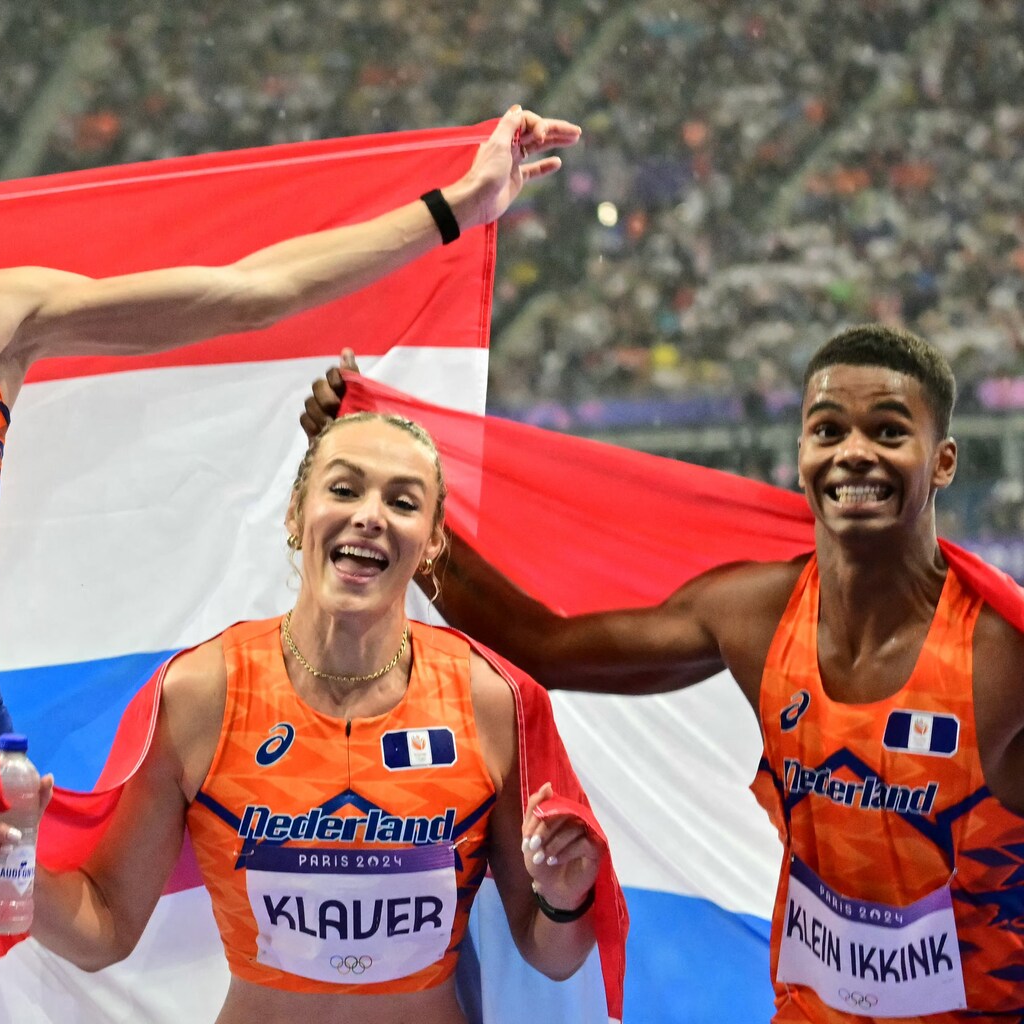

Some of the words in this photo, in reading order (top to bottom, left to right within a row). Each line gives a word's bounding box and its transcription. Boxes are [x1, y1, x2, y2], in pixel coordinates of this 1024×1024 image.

[298, 854, 349, 867] PARIS
[356, 855, 403, 868] 2024
[263, 894, 444, 940] KLAVER
[819, 883, 852, 916] PARIS
[859, 906, 903, 924] 2024
[786, 899, 842, 972] KLEIN
[850, 932, 954, 984] IKKINK
